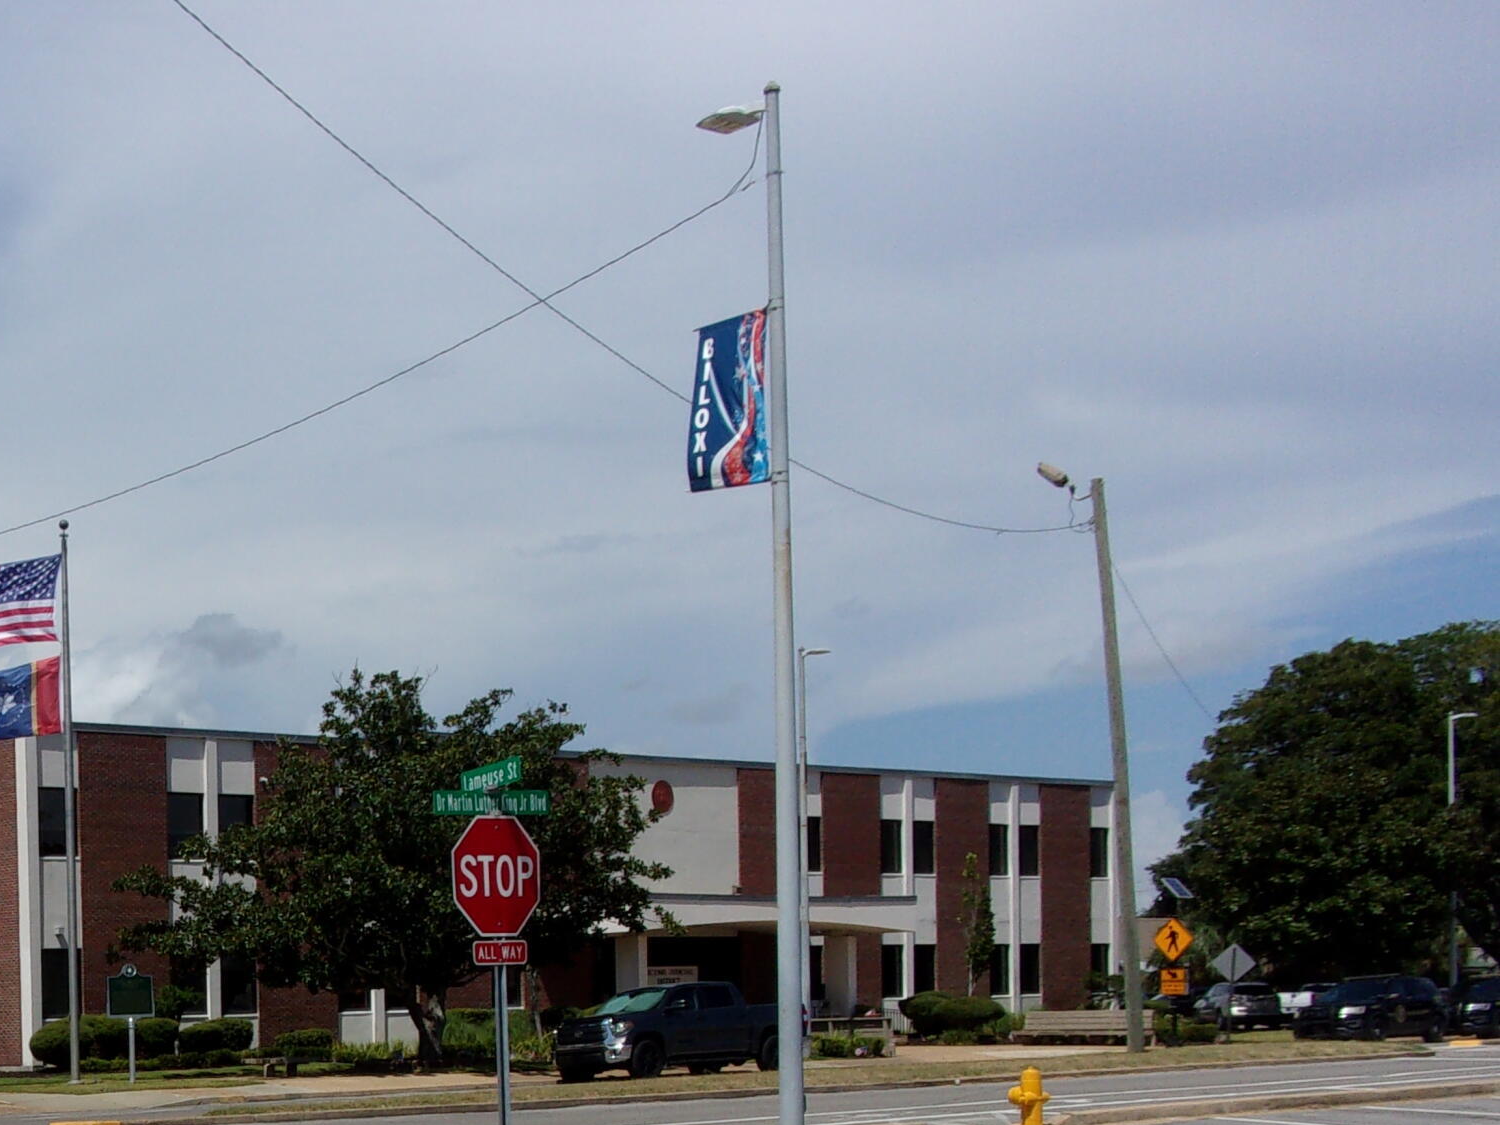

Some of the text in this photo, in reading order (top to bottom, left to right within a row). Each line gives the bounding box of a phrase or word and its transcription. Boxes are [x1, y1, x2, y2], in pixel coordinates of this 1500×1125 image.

[693, 337, 715, 478] BILOXI
[462, 761, 518, 792] Lameuse St
[436, 792, 547, 815] Dr Martin Luther King Jr Blvd
[460, 854, 534, 898] STOP
[478, 945, 523, 960] ALL WAY
